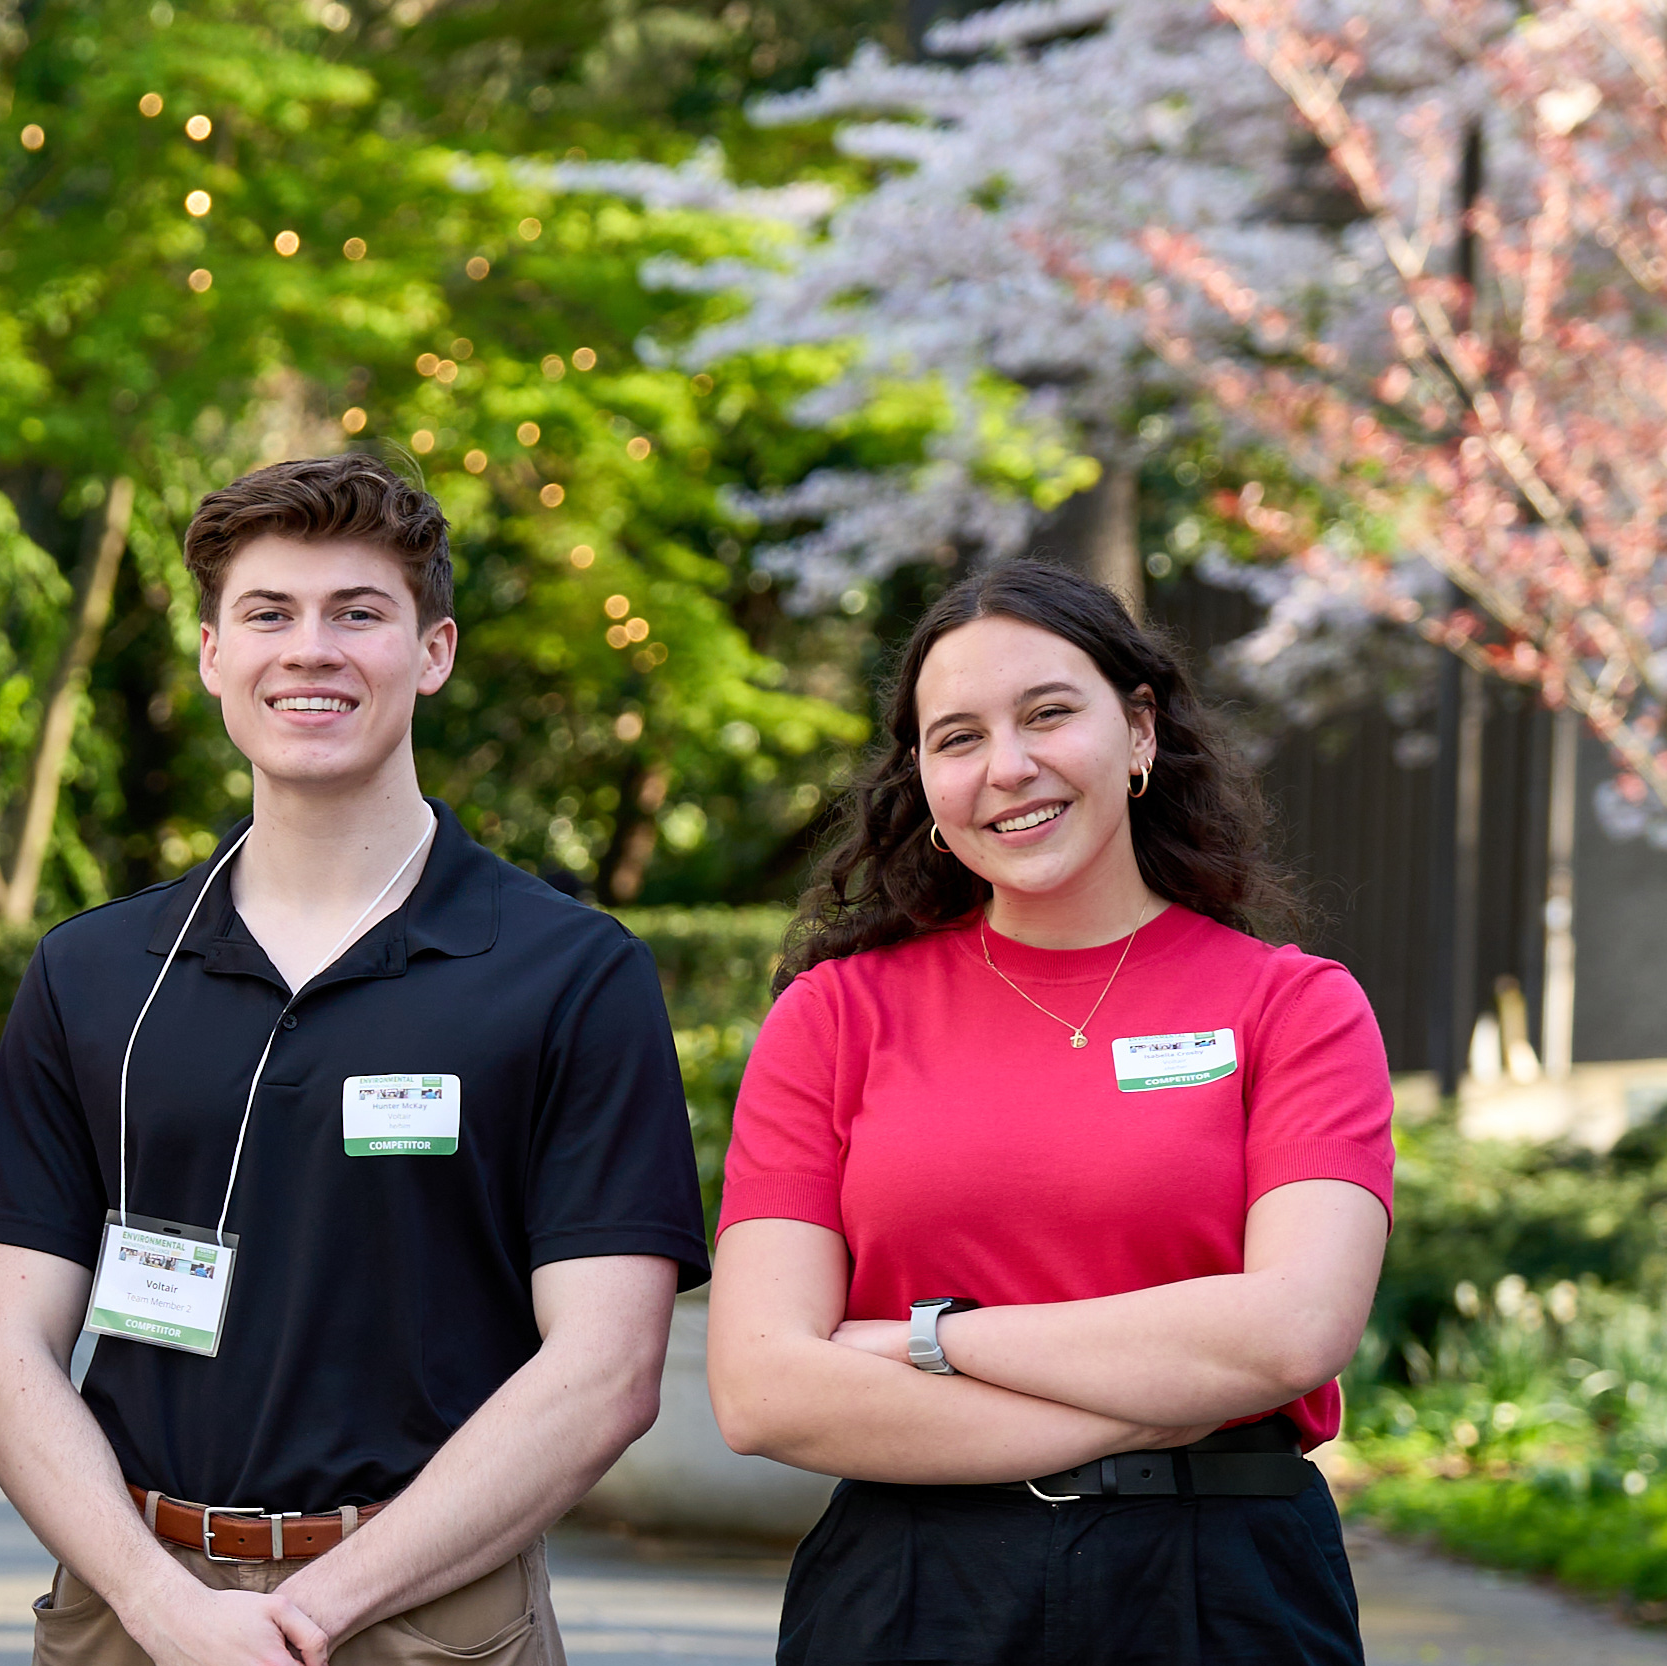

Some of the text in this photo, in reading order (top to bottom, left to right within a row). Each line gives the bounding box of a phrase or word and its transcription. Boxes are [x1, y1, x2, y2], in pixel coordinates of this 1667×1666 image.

[1145, 1072, 1210, 1085] COMPETITOR
[402, 1103, 427, 1111] McKay
[369, 1140, 431, 1151] COMPETITOR
[122, 1230, 185, 1252] ENVIRONMENTAL
[146, 1279, 179, 1294] Voltair
[126, 1292, 192, 1313] Team Member 2
[125, 1318, 182, 1338] COMPETITOR
